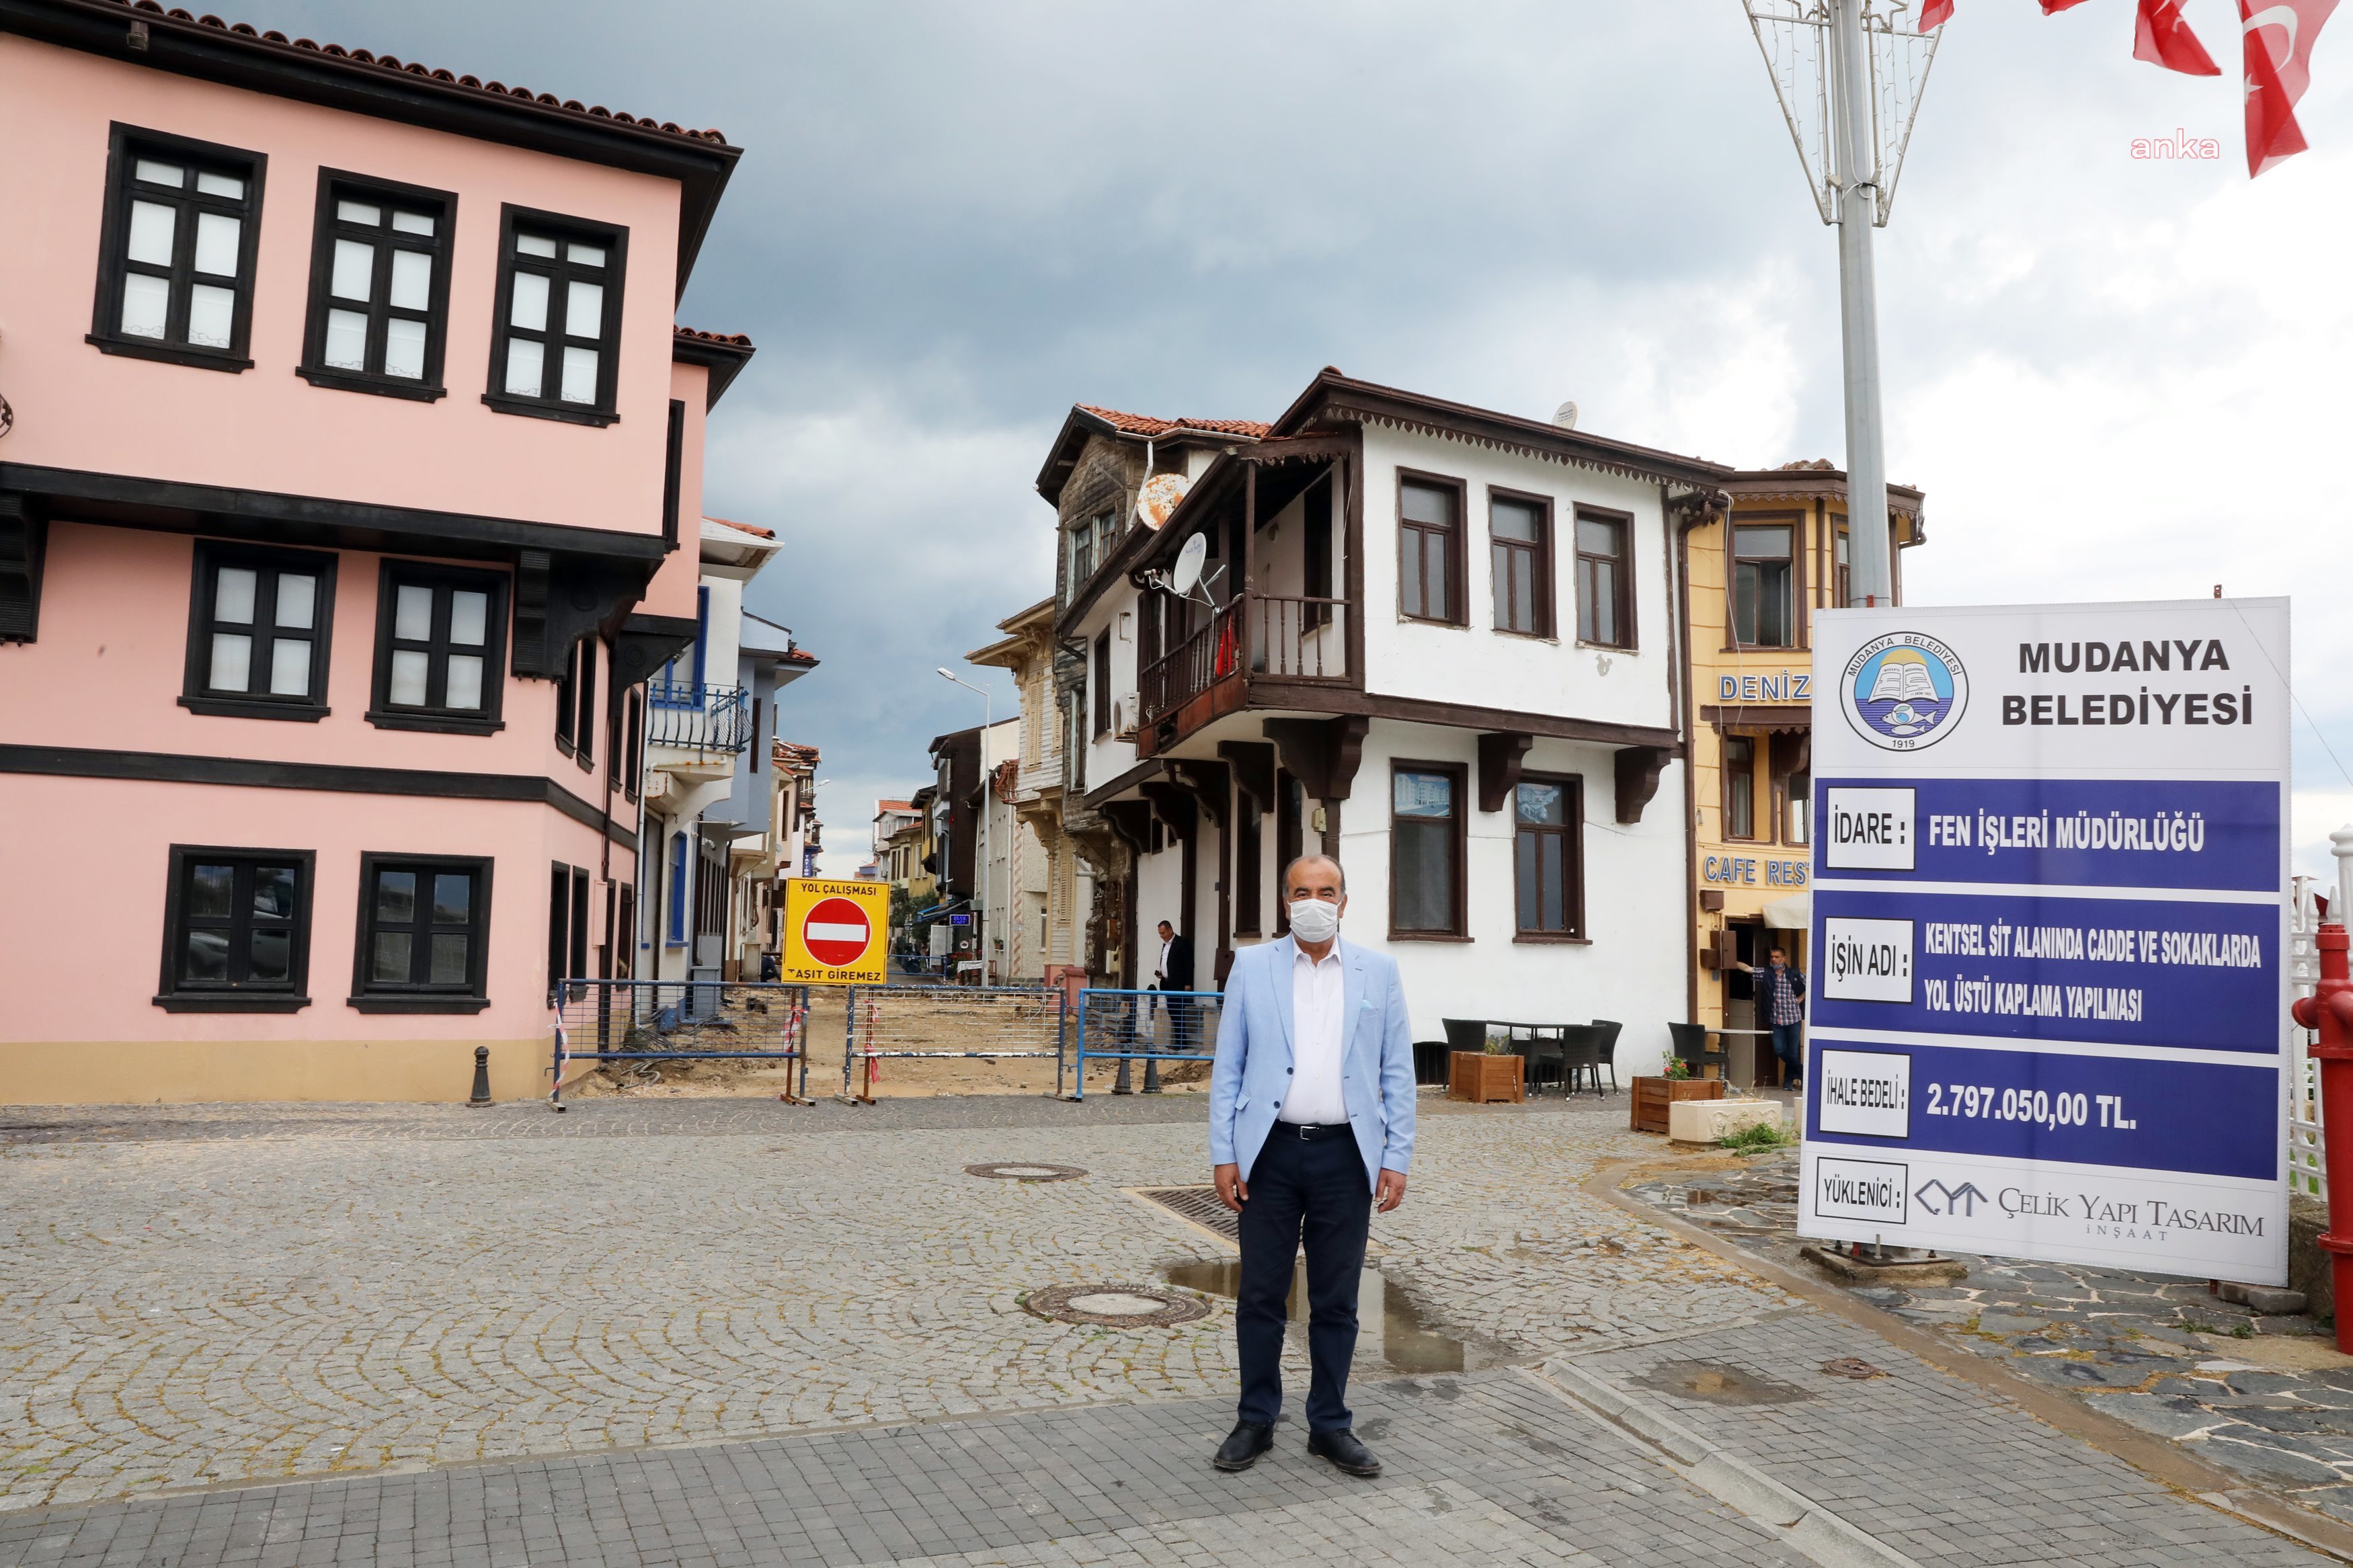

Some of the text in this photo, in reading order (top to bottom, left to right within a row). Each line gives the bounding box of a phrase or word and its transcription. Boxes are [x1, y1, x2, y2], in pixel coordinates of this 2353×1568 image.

[1848, 636, 1960, 677] MUDANYA BELEDİYESİ
[2020, 639, 2230, 673] MUDANYA
[1720, 669, 1811, 700] DENİZ
[2002, 686, 2253, 726] BELEDİYESİ
[1835, 804, 1892, 844] İDARE
[1929, 808, 2204, 856] FEN İŞLERİ MÜDÜRLÜĞÜ
[801, 883, 876, 896] YOL ÇALIŞMASI
[1704, 855, 1809, 886] CAFE RES
[1831, 934, 1863, 982] İŞİN
[1867, 944, 1896, 977] ADI
[1925, 917, 2262, 968] KENTSEL SİT ALANINDA CADDE VE SOKAKLARDA
[828, 968, 881, 981] GİREMEZ
[1924, 974, 2142, 1022] YOL ÜSTÜ KAPLAMA YAPILMASI
[1827, 1069, 1857, 1106] İHALE
[1860, 1073, 1899, 1110] BEDELİ
[1926, 1083, 2137, 1132] 2.797.050,00 TL.
[1824, 1173, 1892, 1208] YÜKLENİCİ
[1998, 1188, 2266, 1237] ÇELİK YAPI TASARIM
